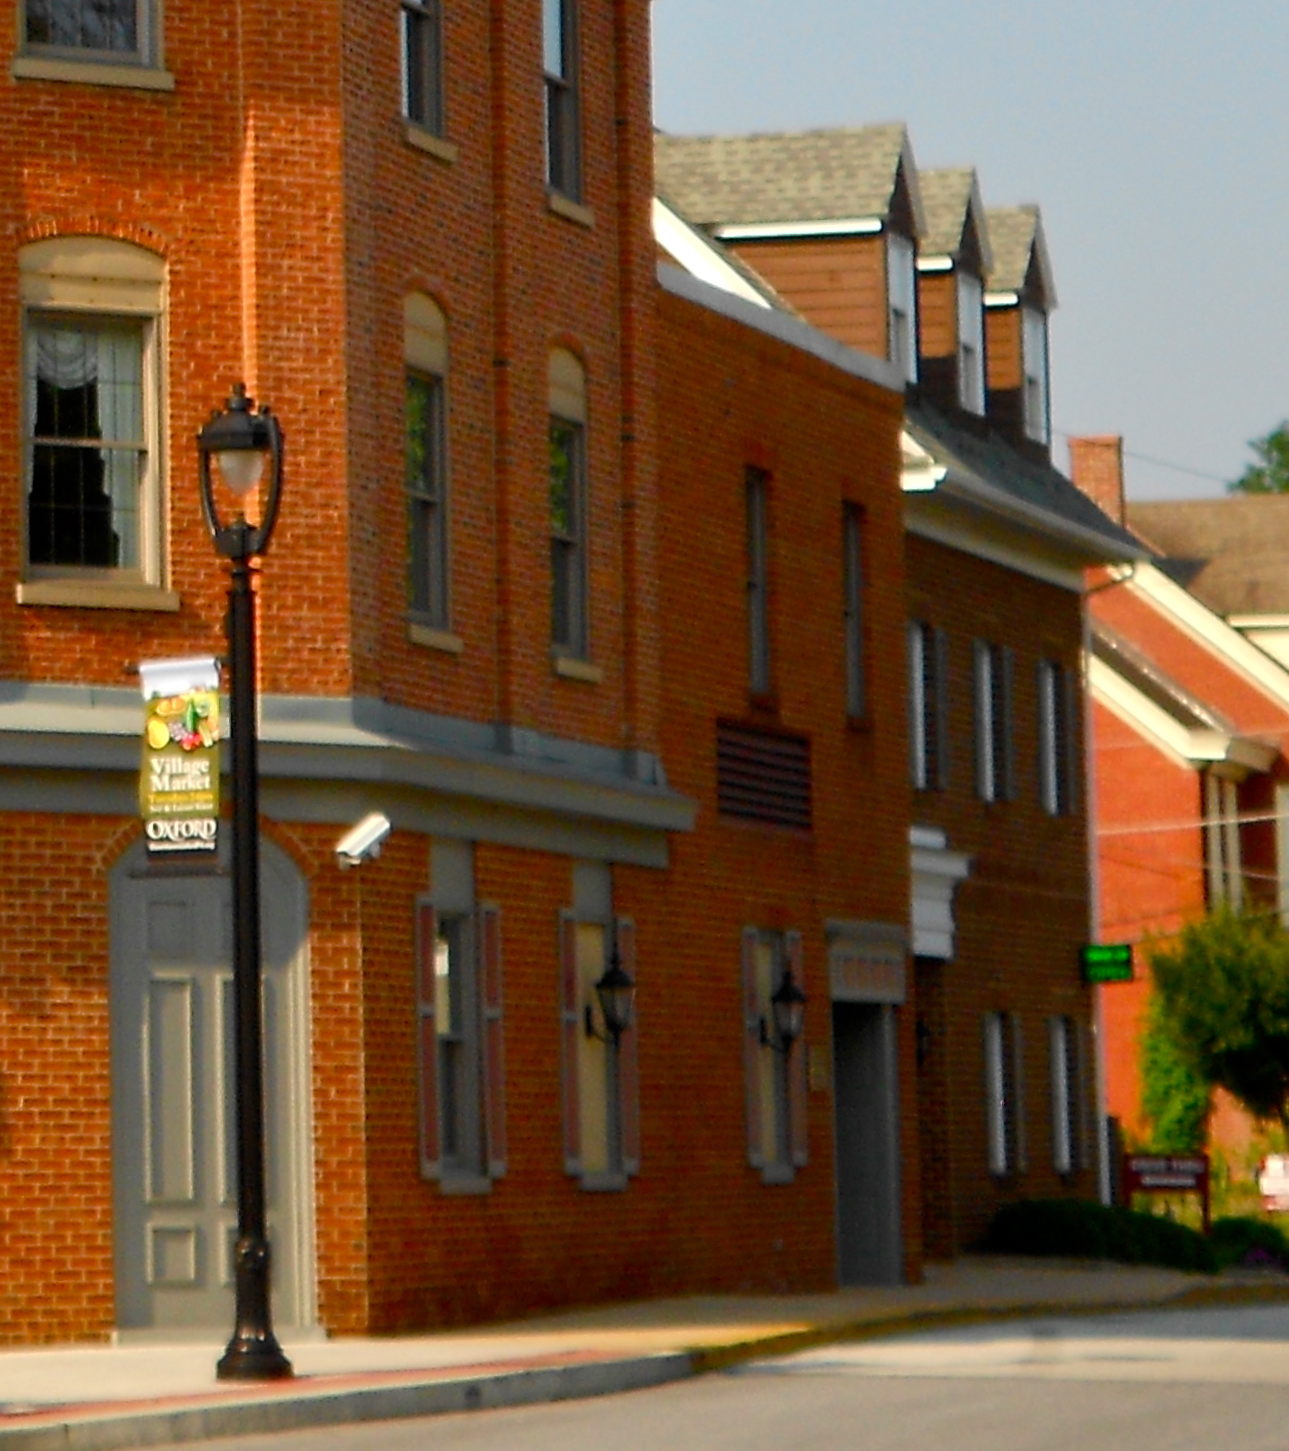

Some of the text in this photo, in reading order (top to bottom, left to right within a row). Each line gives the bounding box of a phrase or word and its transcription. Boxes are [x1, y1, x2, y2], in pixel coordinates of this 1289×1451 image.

[151, 757, 210, 775] Village
[151, 774, 211, 791] Market
[147, 818, 217, 842] OXFORD
